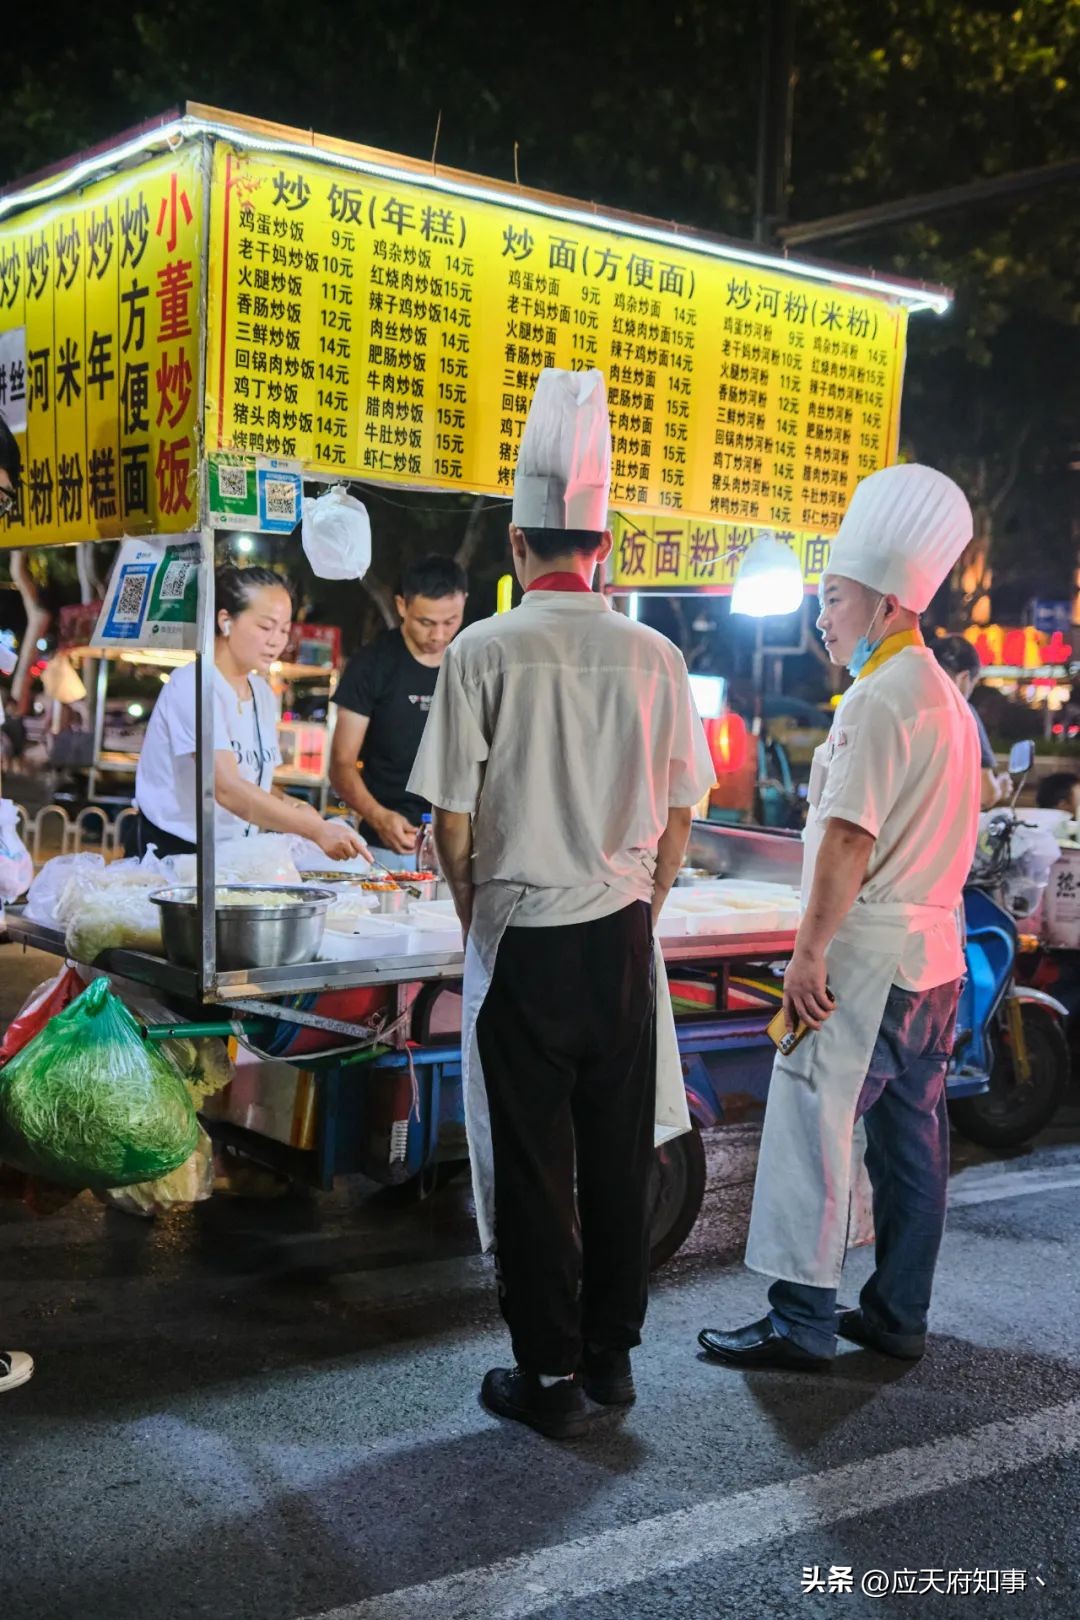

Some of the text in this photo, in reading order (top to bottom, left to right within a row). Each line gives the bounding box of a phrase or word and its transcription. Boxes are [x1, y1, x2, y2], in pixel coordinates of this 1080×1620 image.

[239, 210, 355, 251] 鸡蛋炒饭 9元
[238, 238, 353, 278] 老干妈炒饭 10元
[373, 239, 474, 277] 鸡杂炒饭 14元
[238, 266, 353, 305] 火腿炒饭 11元
[370, 265, 472, 302] 红烧肉炒饭 15元
[508, 269, 600, 305] 鸡蛋炒面 9元
[237, 293, 351, 332] 香肠炒饭 12元
[369, 291, 471, 328] 辣子鸡炒饭 14元
[507, 293, 599, 330] 老干妈炒面 10元
[614, 292, 696, 326] 鸡杂炒面 14元
[726, 277, 878, 340] 炒河粉(米粉)
[156, 173, 193, 516] 小董炒饭
[236, 322, 350, 358] 三鲜炒饭 14元
[370, 317, 470, 353] 肉丝炒饭 14元
[506, 319, 597, 354] 火腿炒面 11元
[612, 316, 695, 349] 红烧肉炒面 15元
[723, 316, 804, 348] 鸡蛋炒河粉 9元
[56, 217, 83, 522] 炒米粉
[87, 205, 117, 519] 炒年糕
[120, 190, 150, 517] 炒方便面
[235, 349, 350, 385] 回锅肉炒饭 14元
[368, 344, 468, 378] 肥肠炒饭 15元
[504, 343, 555, 368] 香肠炒面
[610, 339, 693, 372] 辣子鸡炒面 14元
[722, 339, 802, 370] 老干妈炒河粉 10元
[869, 349, 887, 366] 14元
[27, 230, 53, 525] 炒河粉
[366, 370, 467, 404] 牛肉炒饭 15元
[610, 364, 691, 396] 肉丝炒面 14元
[720, 362, 800, 392] 火腿炒河粉 11元
[866, 370, 885, 387] 15元
[234, 376, 348, 412] 鸡丁炒饭 14元
[608, 388, 690, 418] 肥肠炒面 15元
[719, 384, 799, 414] 香肠炒河粉 12元
[865, 391, 884, 409] 14元
[233, 402, 348, 438] 猪头肉炒饭 14元
[366, 396, 465, 429] 腊肉炒饭 15元
[717, 407, 798, 436] 三鲜炒河粉 14元
[863, 412, 882, 429] 14元
[232, 430, 346, 464] 烤鸭炒饭 14元
[365, 422, 464, 454] 牛肚炒饭 15元
[665, 422, 688, 441] 15元
[715, 429, 796, 458] 回锅肉炒河粉 14元
[861, 433, 880, 450] 15元
[364, 447, 463, 479] 虾仁炒饭 15元
[664, 446, 686, 464] 15元
[714, 451, 794, 480] 鸡丁炒河粉 14元
[859, 454, 878, 470] 15元
[611, 460, 685, 487] 肚炒面 15元
[712, 473, 792, 501] 猪头肉炒河粉 14元
[609, 482, 682, 508] 仁炒面 15元
[710, 495, 791, 523] 烤鸭炒河粉 14元
